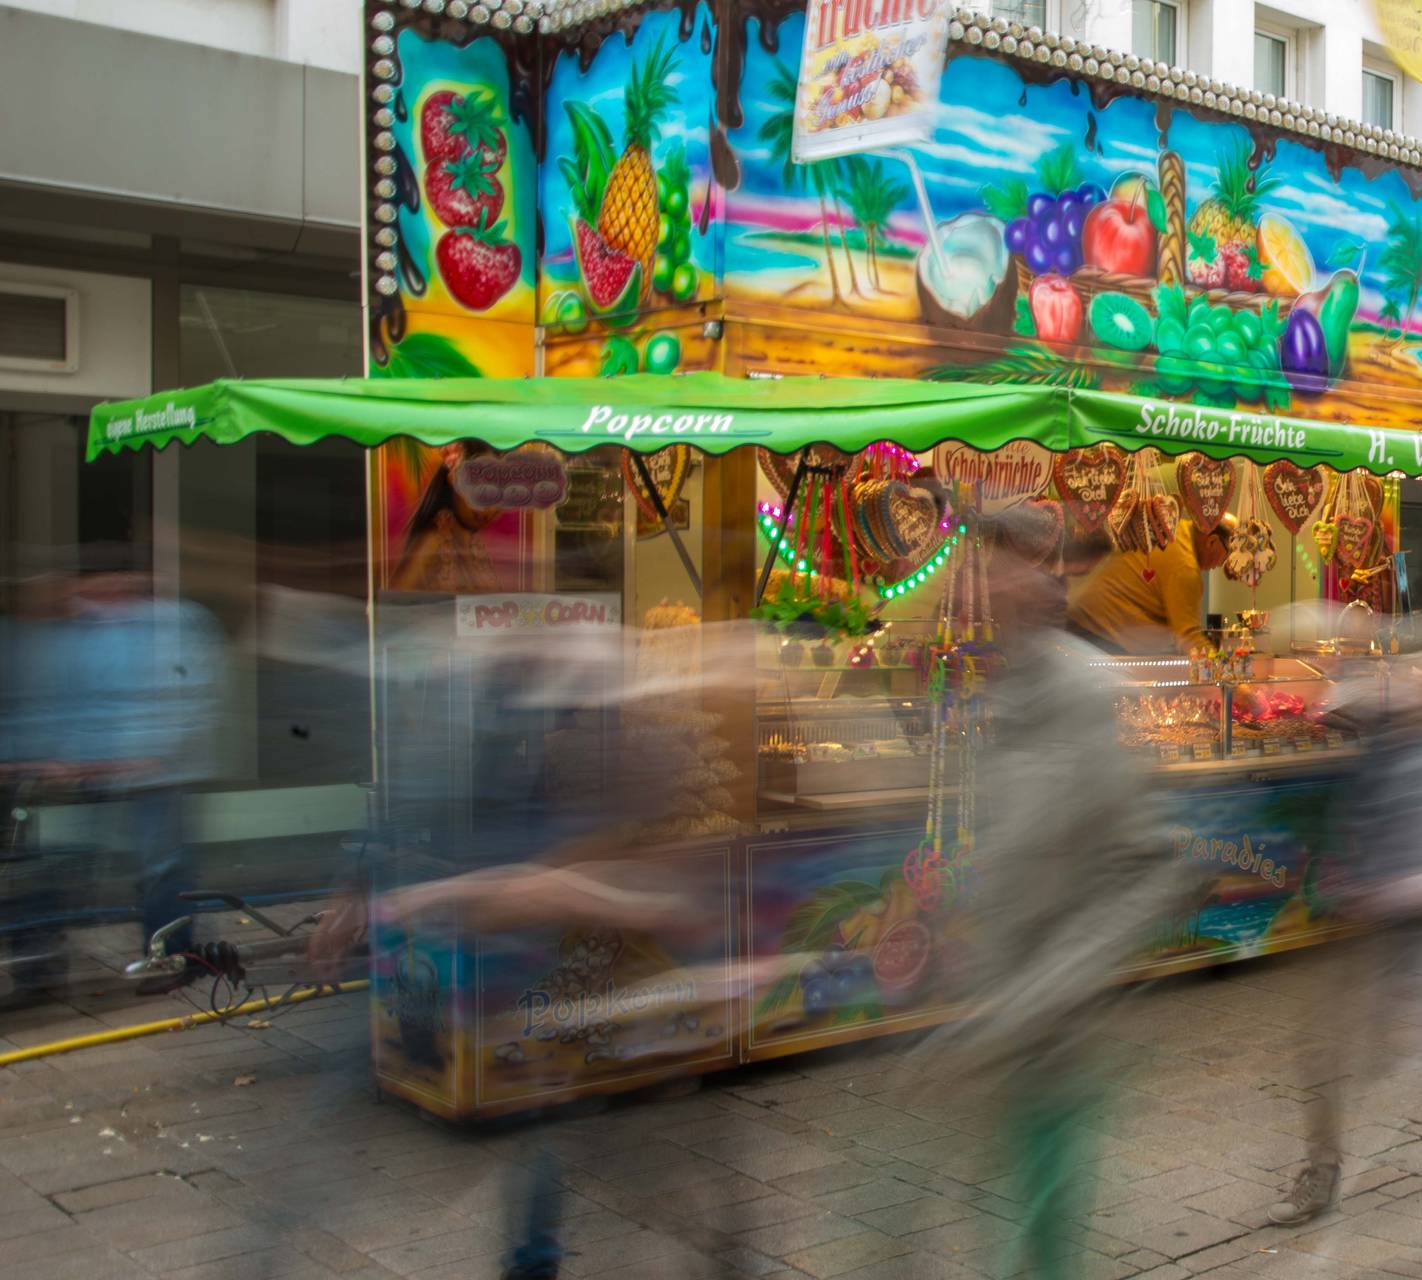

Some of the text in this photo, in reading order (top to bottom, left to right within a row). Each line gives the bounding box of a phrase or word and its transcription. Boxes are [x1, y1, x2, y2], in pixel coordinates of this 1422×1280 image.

[581, 405, 734, 440] Popcorn
[1135, 402, 1307, 449] Schoko-Früchte
[1367, 429, 1394, 465] H.
[474, 601, 607, 629] POP CORN
[1168, 825, 1288, 889] Paradies
[516, 977, 698, 1039] Popkorn
